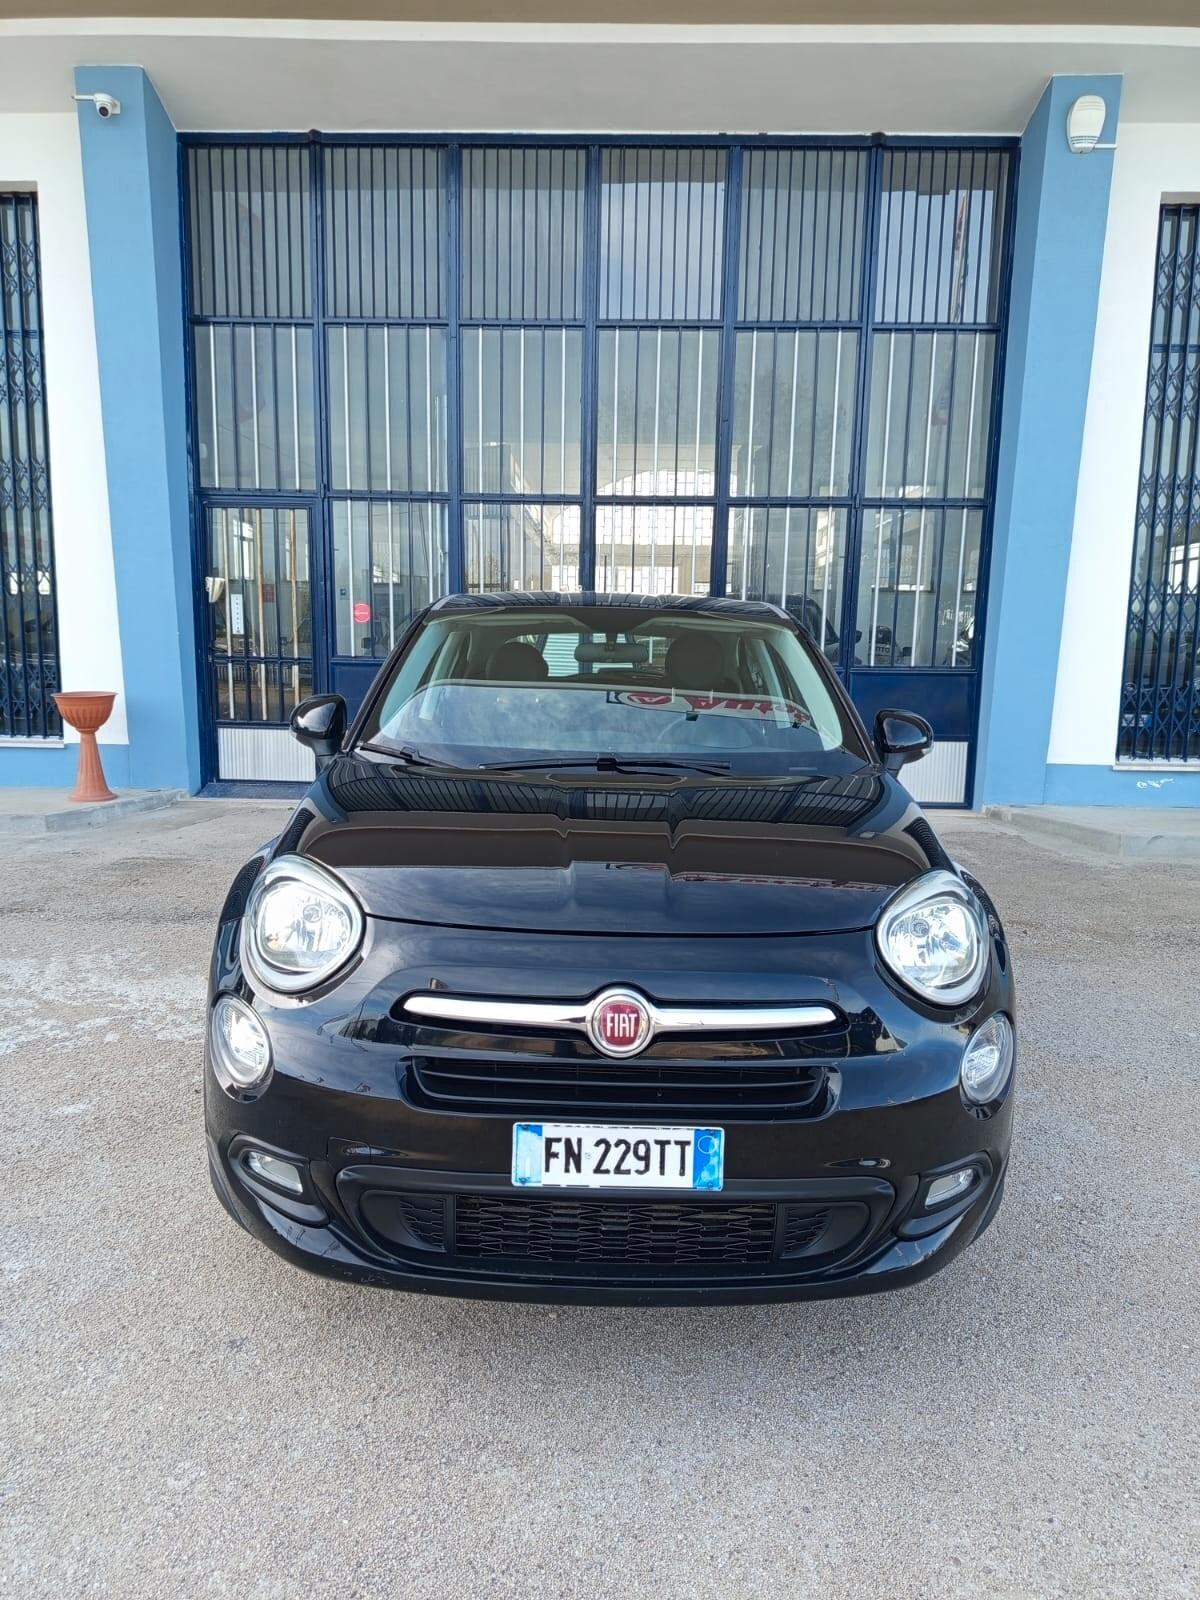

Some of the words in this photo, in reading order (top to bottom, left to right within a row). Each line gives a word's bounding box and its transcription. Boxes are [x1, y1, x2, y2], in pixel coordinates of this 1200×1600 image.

[606, 1013, 638, 1038] FIAT
[544, 1137, 583, 1174] FN
[593, 1138, 692, 1177] 229TT
